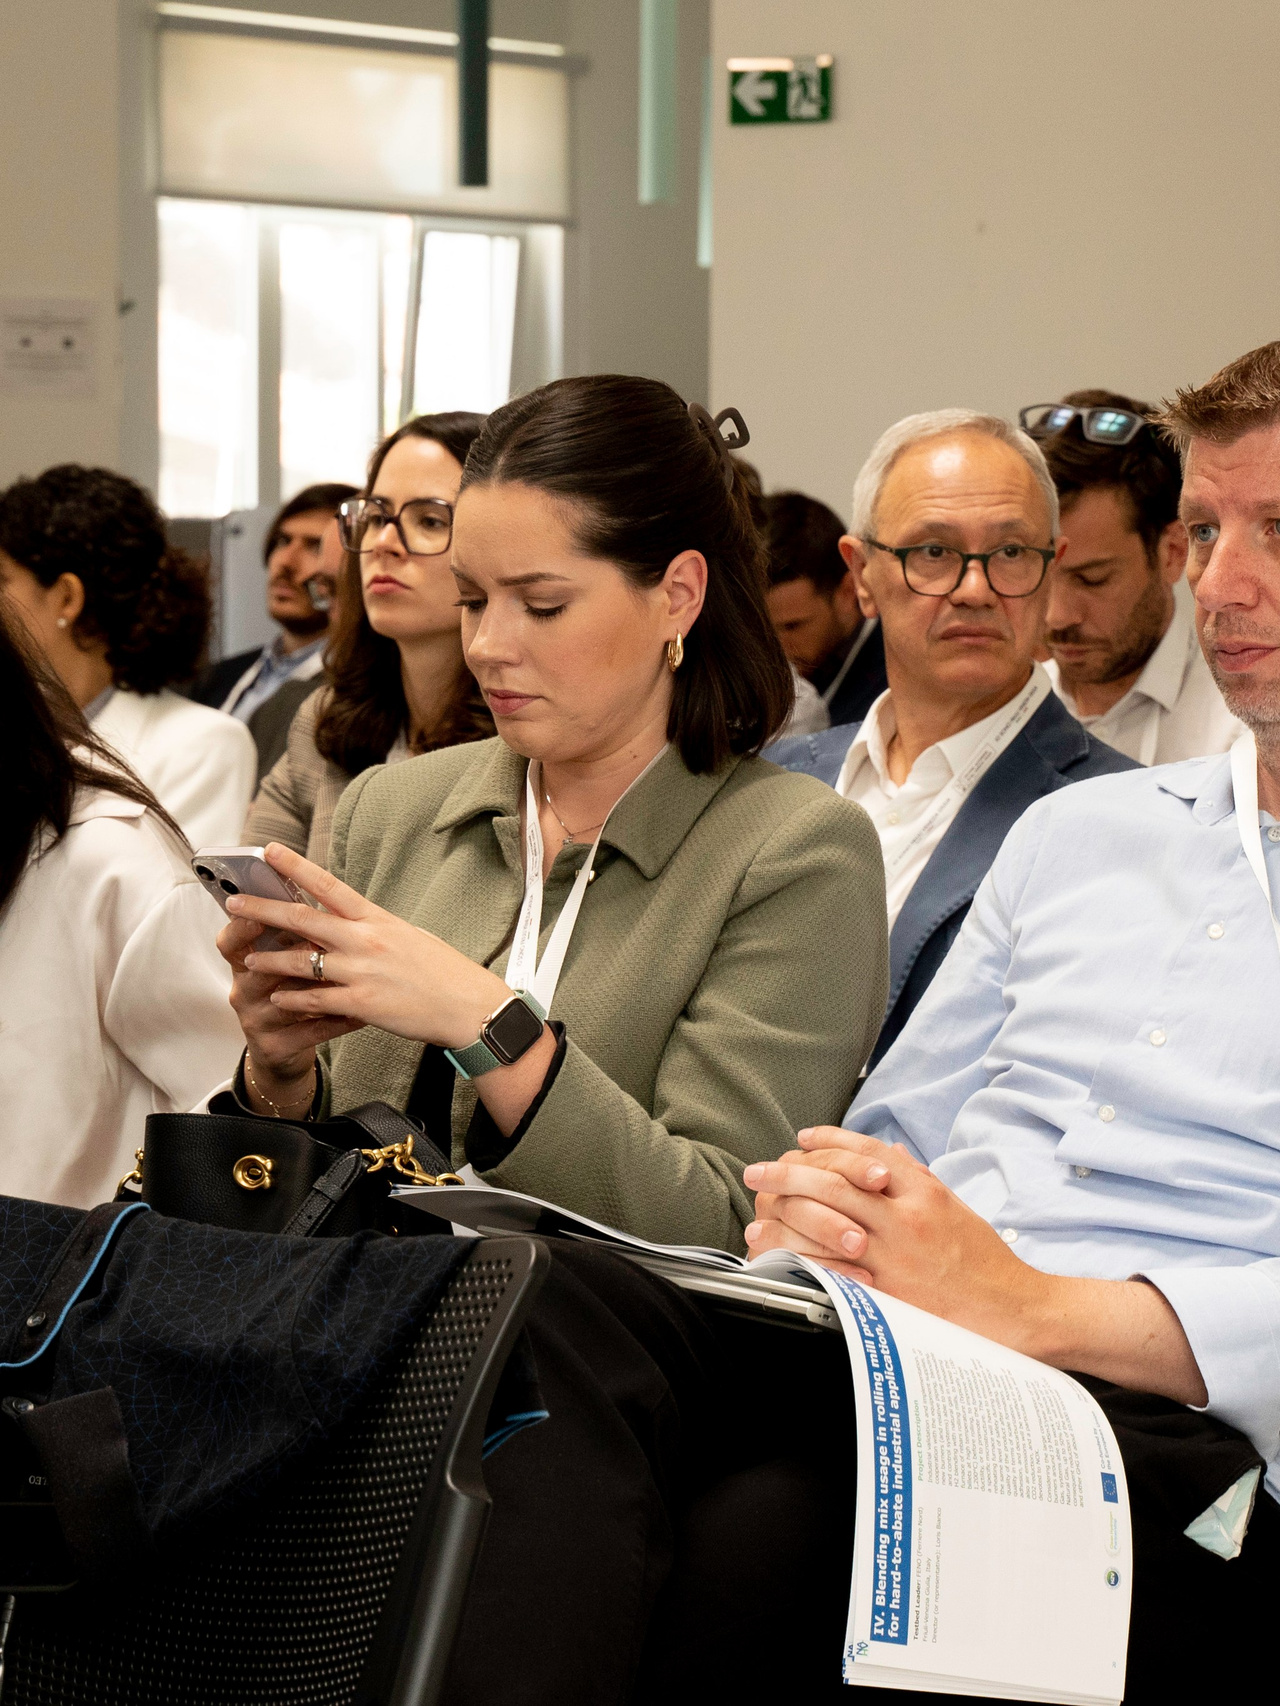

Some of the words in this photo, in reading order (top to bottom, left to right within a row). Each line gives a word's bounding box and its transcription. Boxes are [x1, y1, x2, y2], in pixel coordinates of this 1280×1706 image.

[864, 1339, 880, 1368] mill
[875, 1324, 901, 1409] application,
[873, 1371, 886, 1422] rolling
[876, 1426, 887, 1442] in
[914, 1400, 922, 1448] Description
[879, 1445, 890, 1494] usage
[889, 1413, 903, 1490] industrial
[877, 1498, 888, 1529] mix
[875, 1533, 890, 1607] Blending
[889, 1493, 903, 1609] hard-to-abate
[874, 1611, 885, 1636] IV.
[887, 1612, 900, 1638] for
